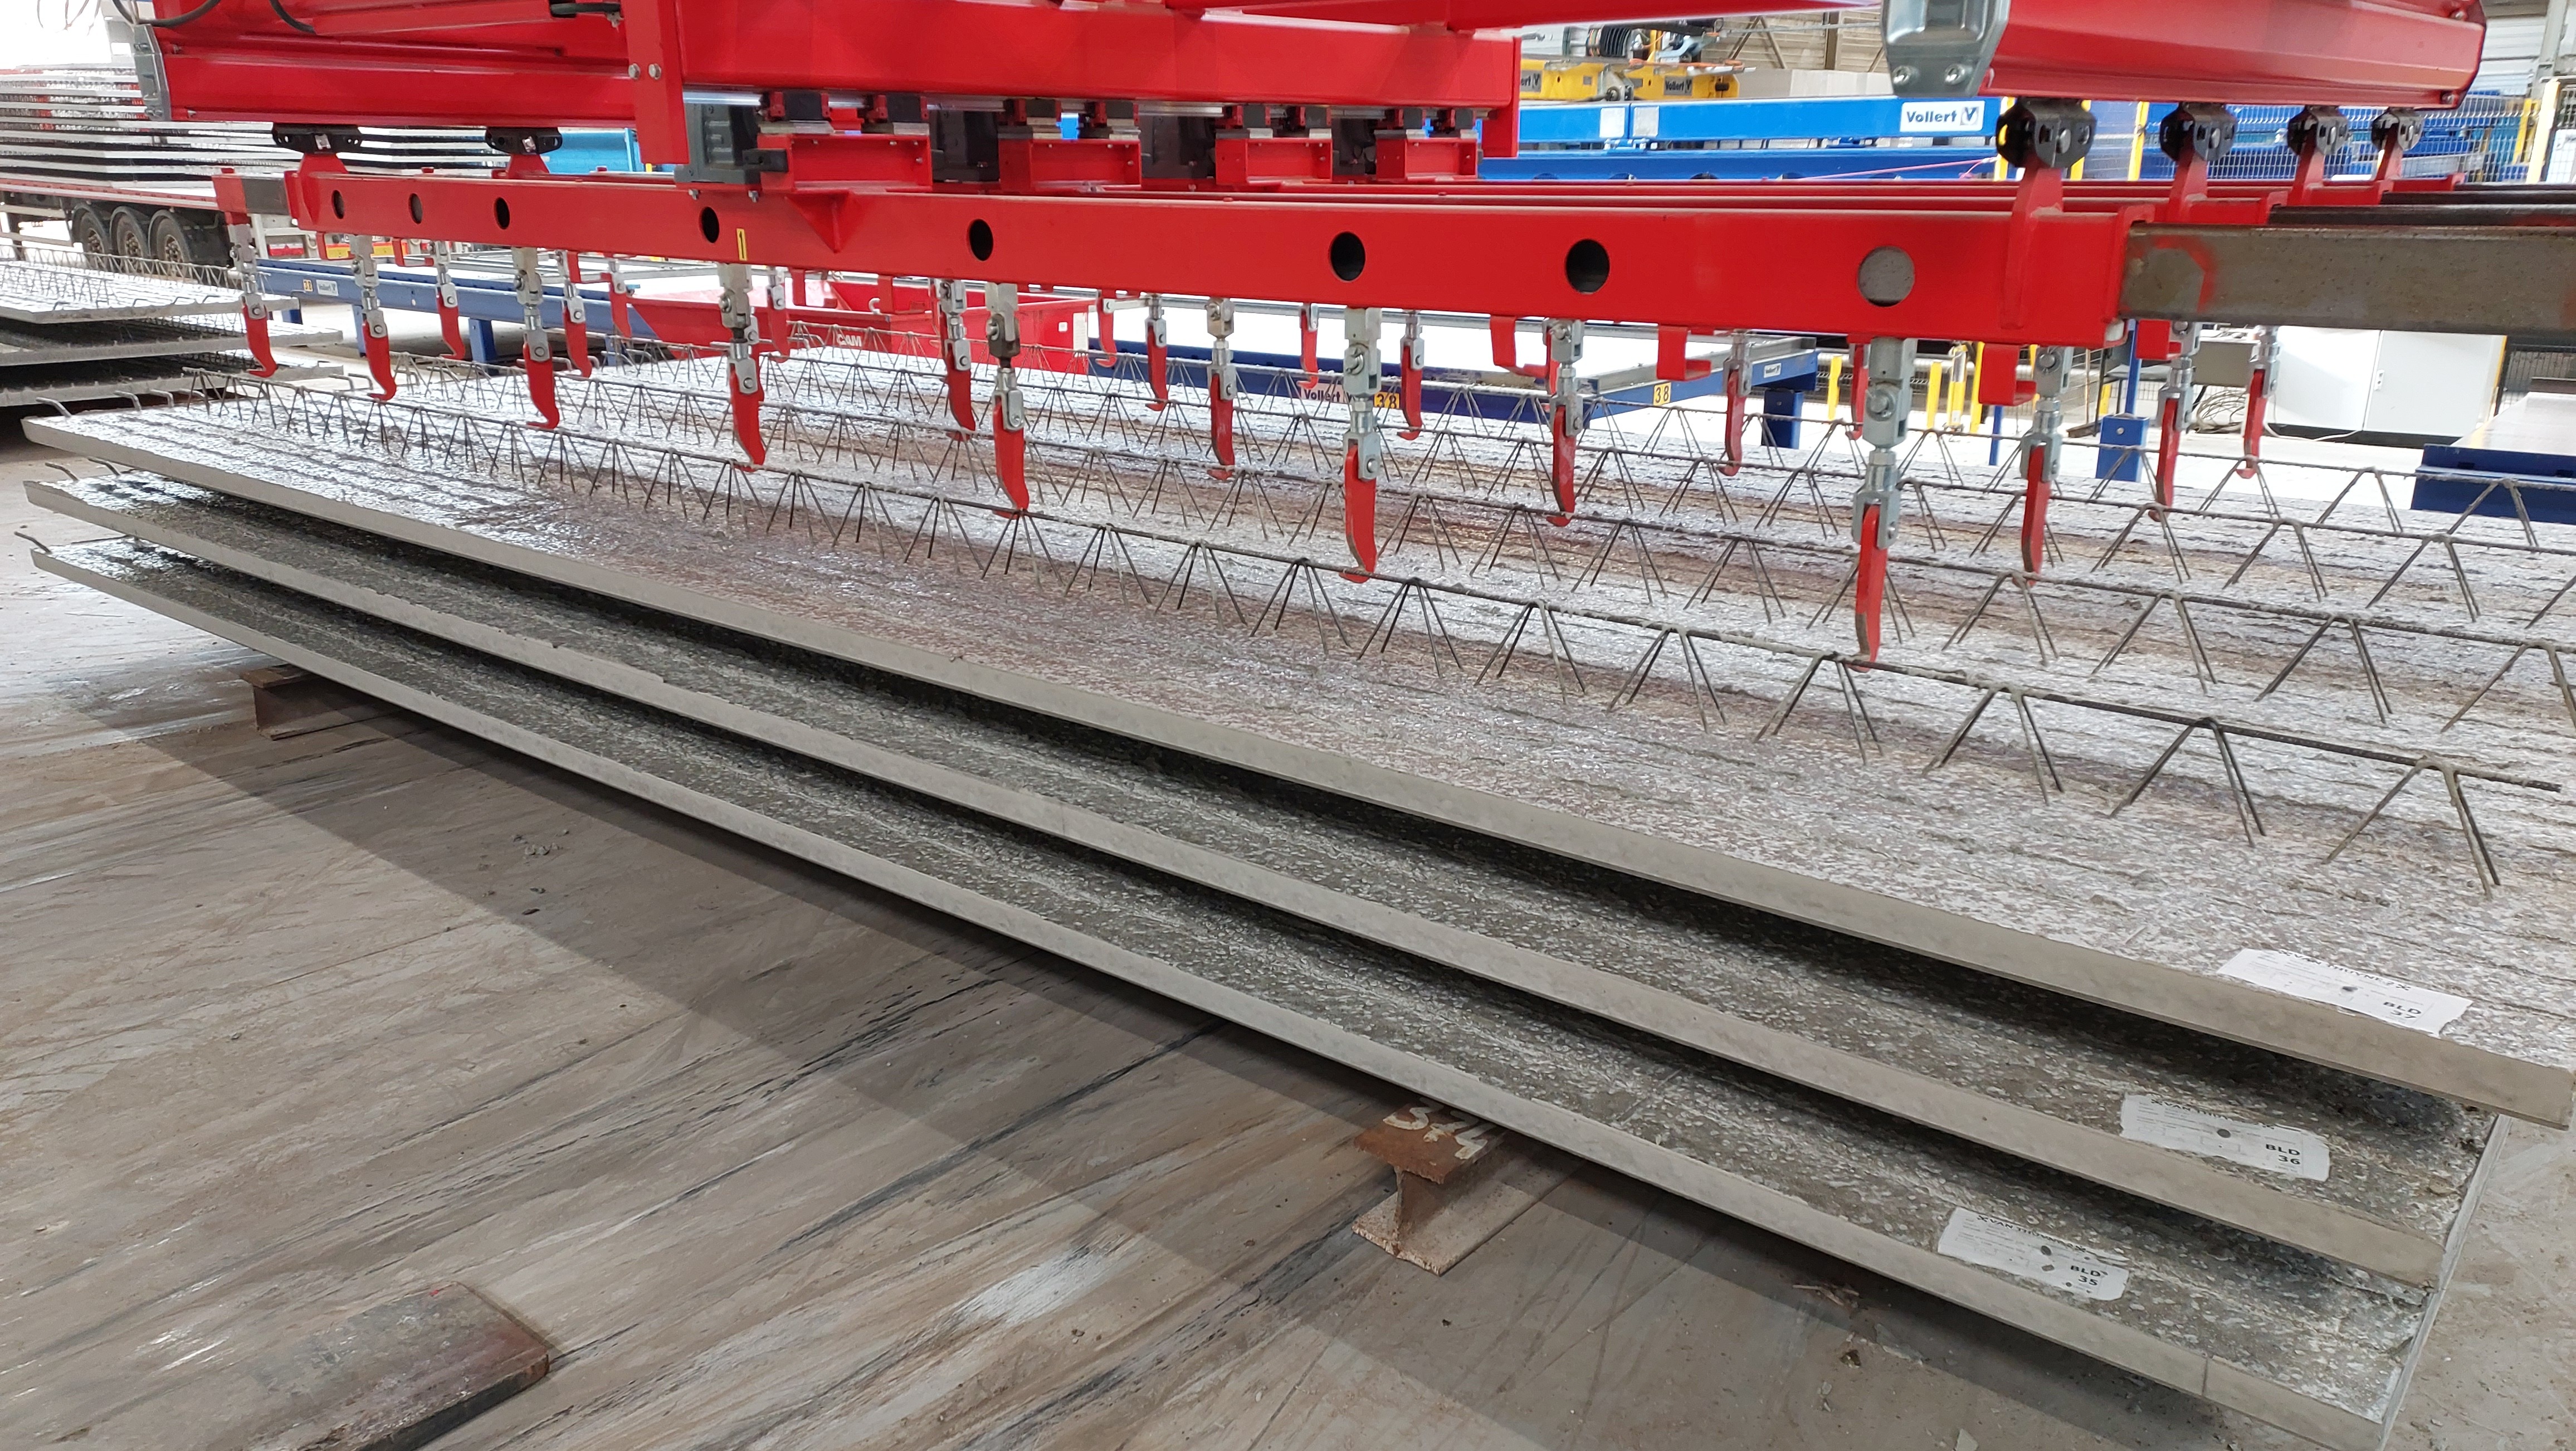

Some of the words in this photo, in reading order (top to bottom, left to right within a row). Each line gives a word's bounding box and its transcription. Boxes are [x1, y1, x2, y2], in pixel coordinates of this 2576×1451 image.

[1906, 110, 1957, 123] Vollert
[739, 231, 744, 259] 1
[1305, 389, 1341, 402] Vollert
[1376, 393, 1397, 408] 38
[1656, 386, 1669, 403] 38
[2383, 1001, 2421, 1014] BLD
[2390, 1010, 2417, 1019] 37
[2164, 1102, 2190, 1111] VAN
[2266, 1144, 2300, 1155] BLD
[2278, 1155, 2300, 1165] 36
[1990, 1219, 2013, 1229] VAN
[2071, 1265, 2101, 1277] BLD
[2078, 1275, 2098, 1286] 35
